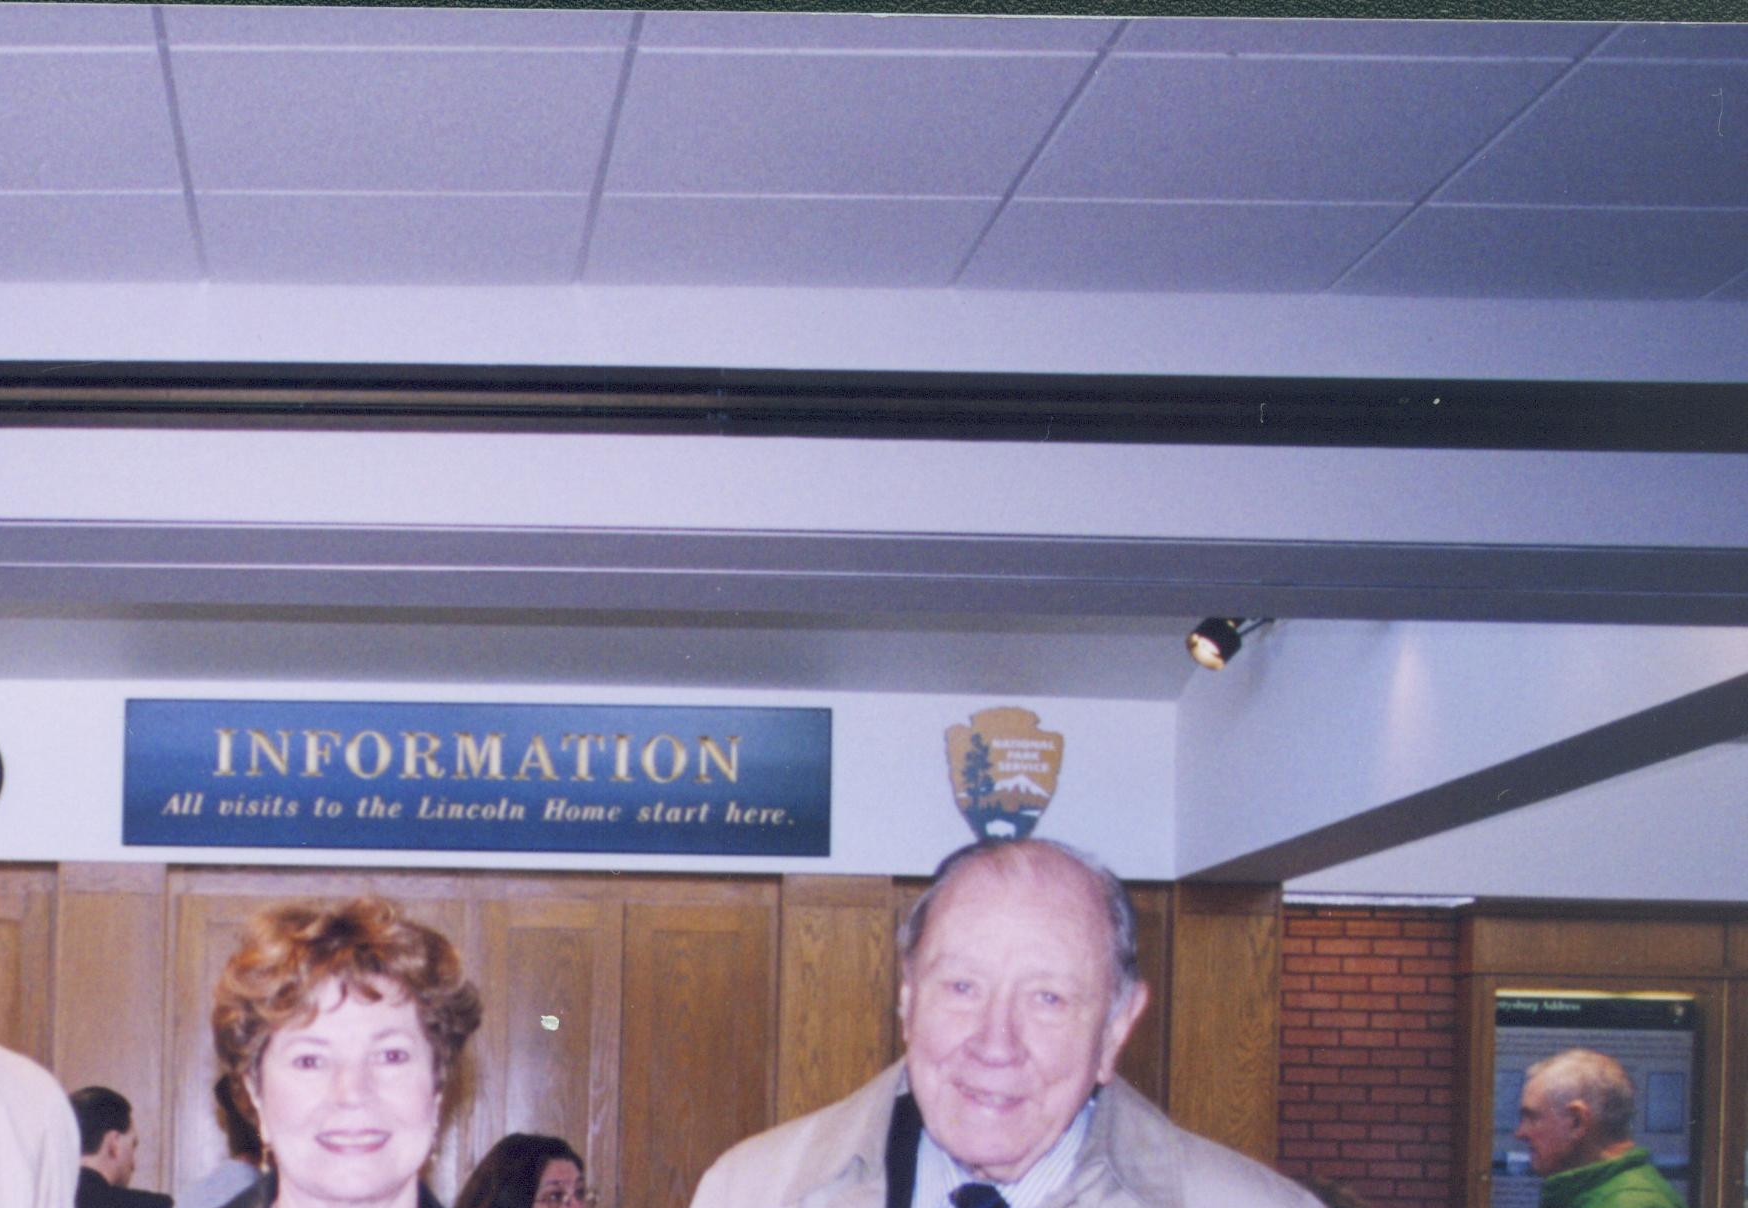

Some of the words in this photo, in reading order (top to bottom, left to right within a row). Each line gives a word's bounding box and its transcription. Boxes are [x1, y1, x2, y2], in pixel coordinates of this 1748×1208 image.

[992, 738, 1054, 750] NATIONAL
[212, 728, 741, 783] INFORMATION
[1006, 751, 1040, 761] PARK
[997, 762, 1050, 772] SERVICE
[162, 793, 203, 816] All
[218, 795, 299, 818] visits
[314, 796, 344, 818] to
[356, 795, 402, 818] the
[418, 796, 525, 821] Lincoln
[543, 798, 622, 822] Home
[636, 802, 709, 823] start
[724, 801, 795, 825] here.
